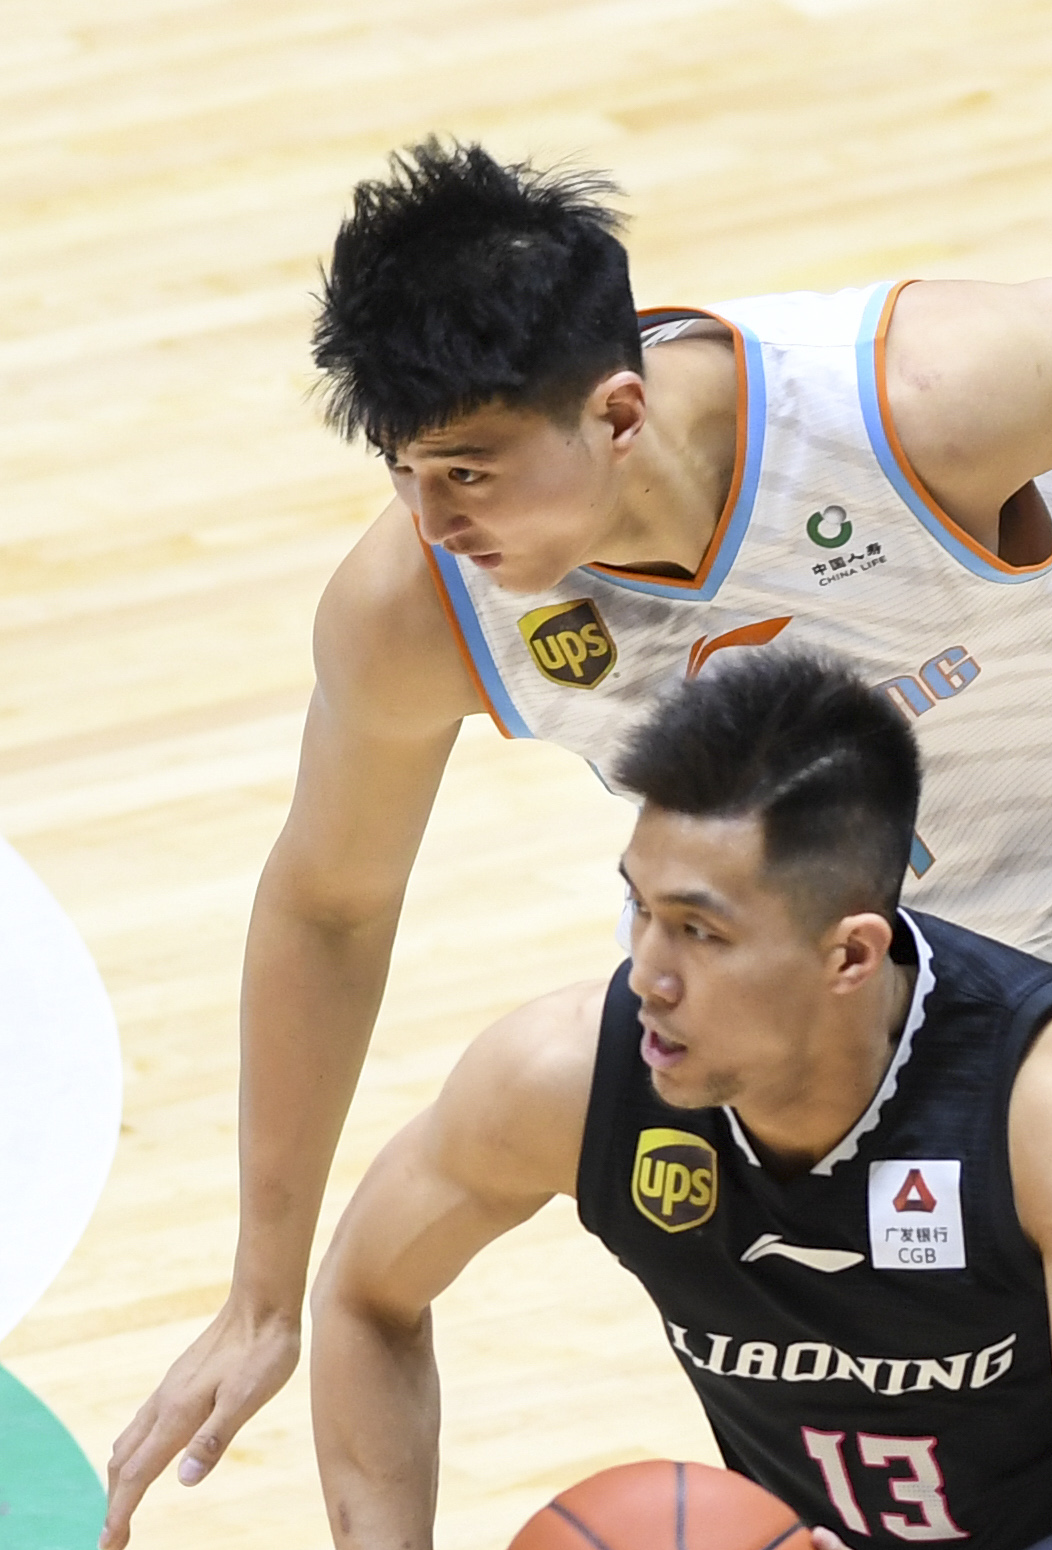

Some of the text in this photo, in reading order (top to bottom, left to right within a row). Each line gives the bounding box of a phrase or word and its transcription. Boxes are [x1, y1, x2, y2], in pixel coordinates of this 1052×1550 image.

[819, 555, 887, 587] CHINA LIFE
[532, 622, 608, 678] ups
[640, 1156, 712, 1216] ups
[885, 1227, 948, 1243] 广发银行
[898, 1247, 937, 1264] CGB
[668, 1321, 1016, 1396] LIAONING
[801, 1426, 971, 1541] 13
